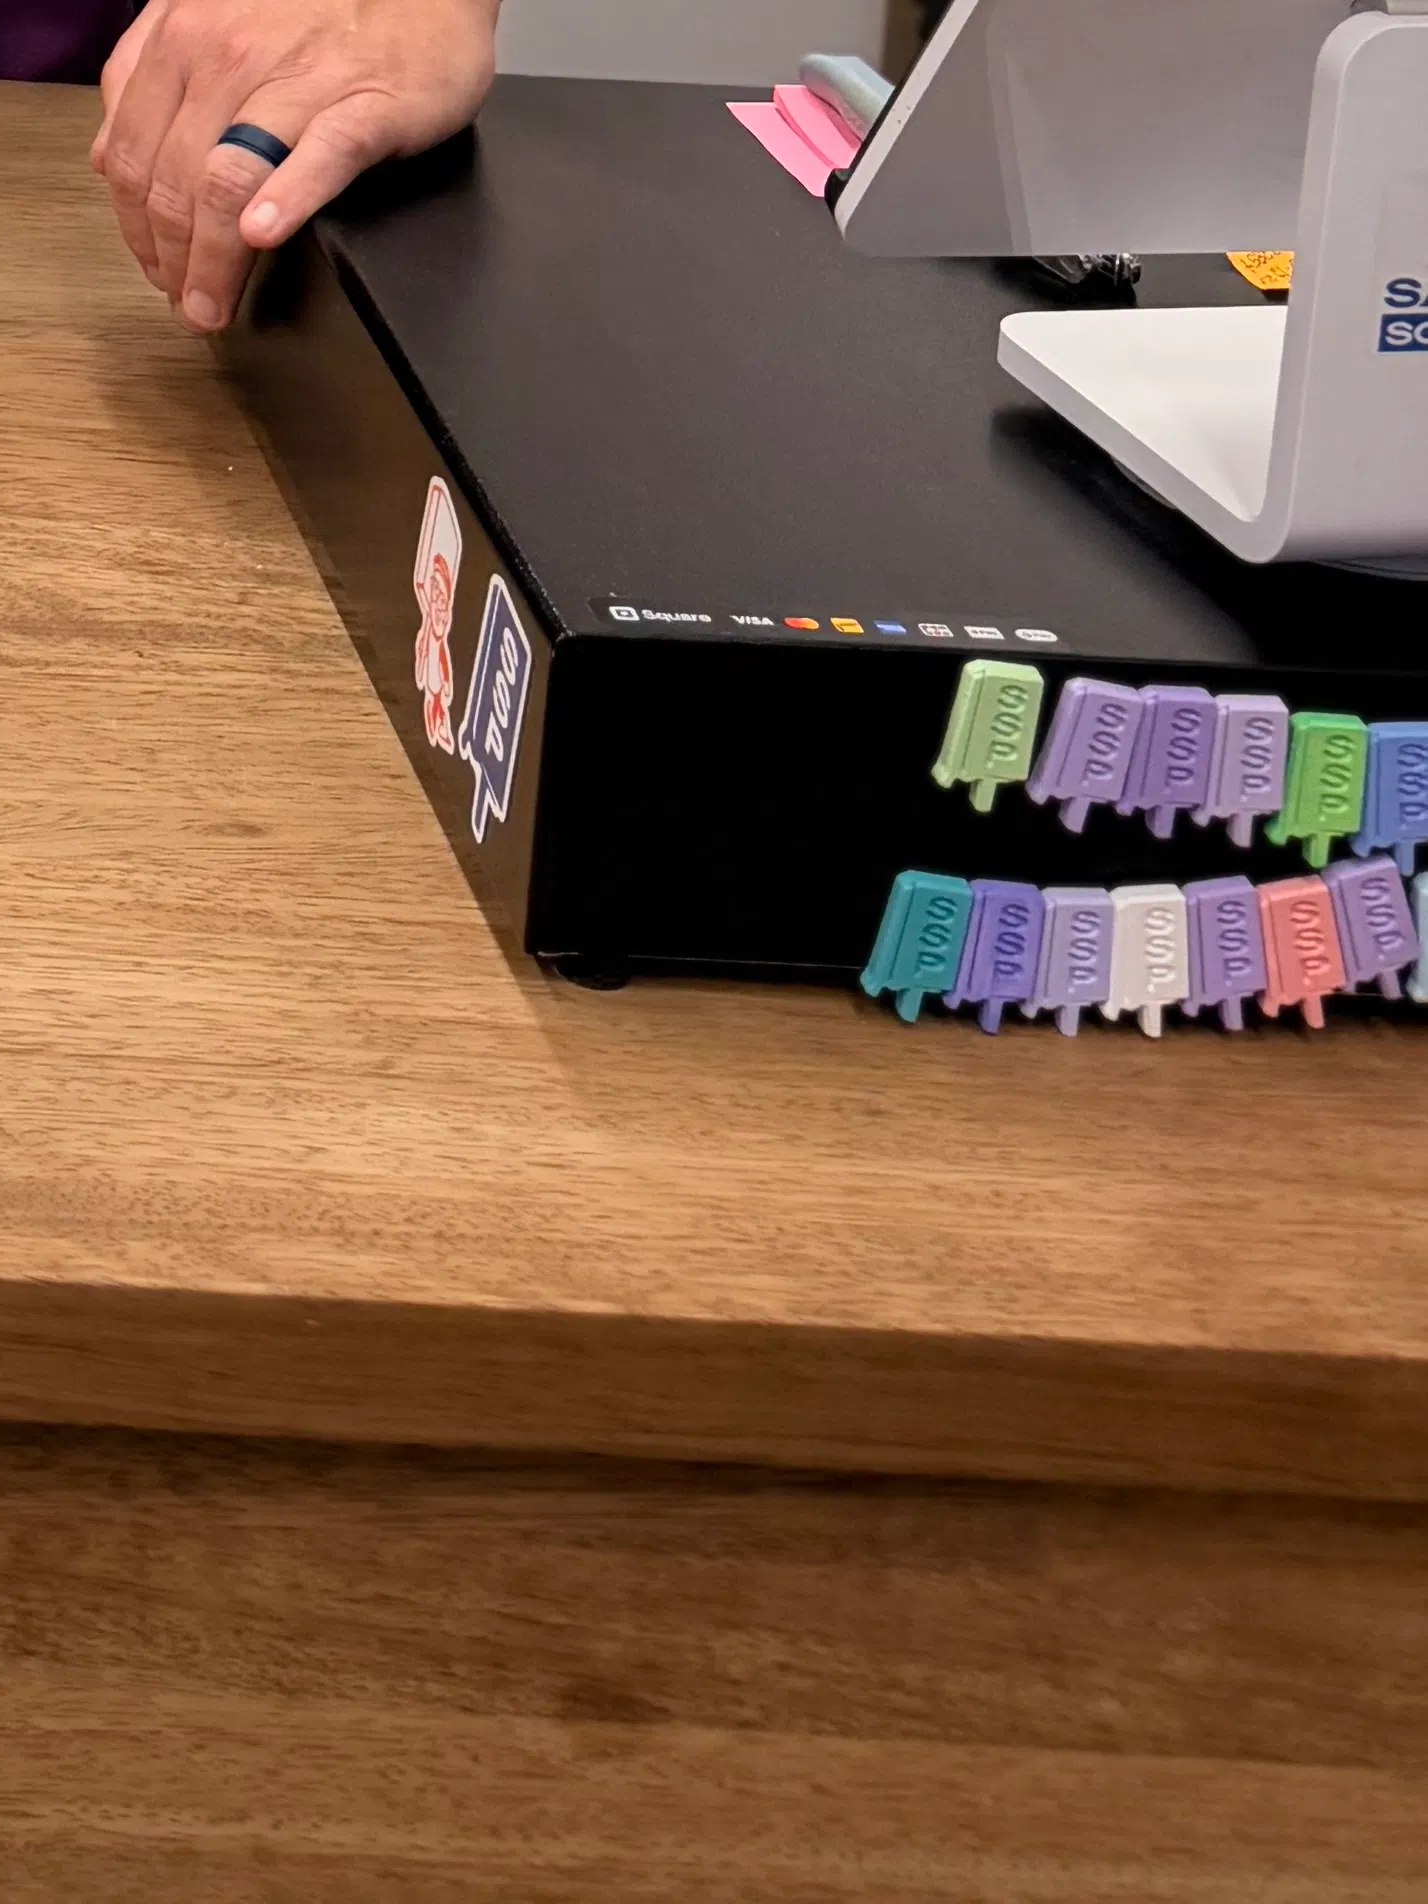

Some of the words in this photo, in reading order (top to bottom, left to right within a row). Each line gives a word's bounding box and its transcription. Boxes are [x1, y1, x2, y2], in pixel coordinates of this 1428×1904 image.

[1384, 277, 1428, 308] S
[641, 609, 712, 623] Square
[730, 614, 774, 626] VISA
[486, 626, 519, 762] SSP
